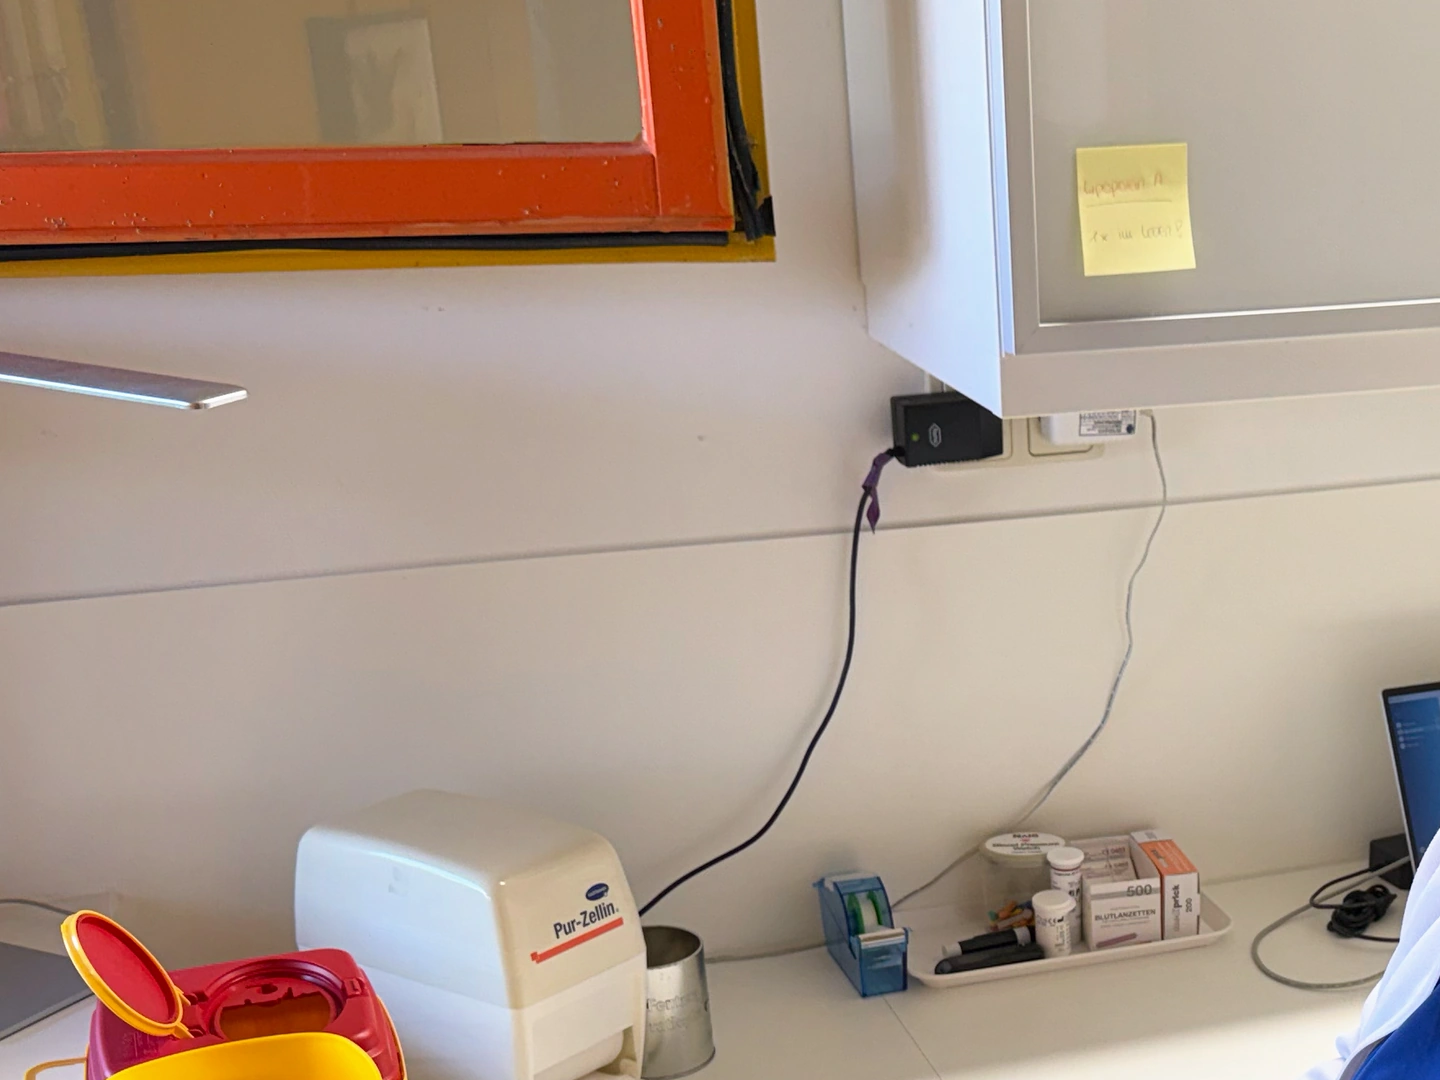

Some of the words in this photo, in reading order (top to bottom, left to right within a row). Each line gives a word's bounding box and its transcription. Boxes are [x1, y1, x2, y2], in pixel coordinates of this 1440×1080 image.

[1126, 883, 1153, 897] 500
[553, 902, 617, 940] Pur-Zellin
[1094, 908, 1156, 921] BLUTLANZETTEN
